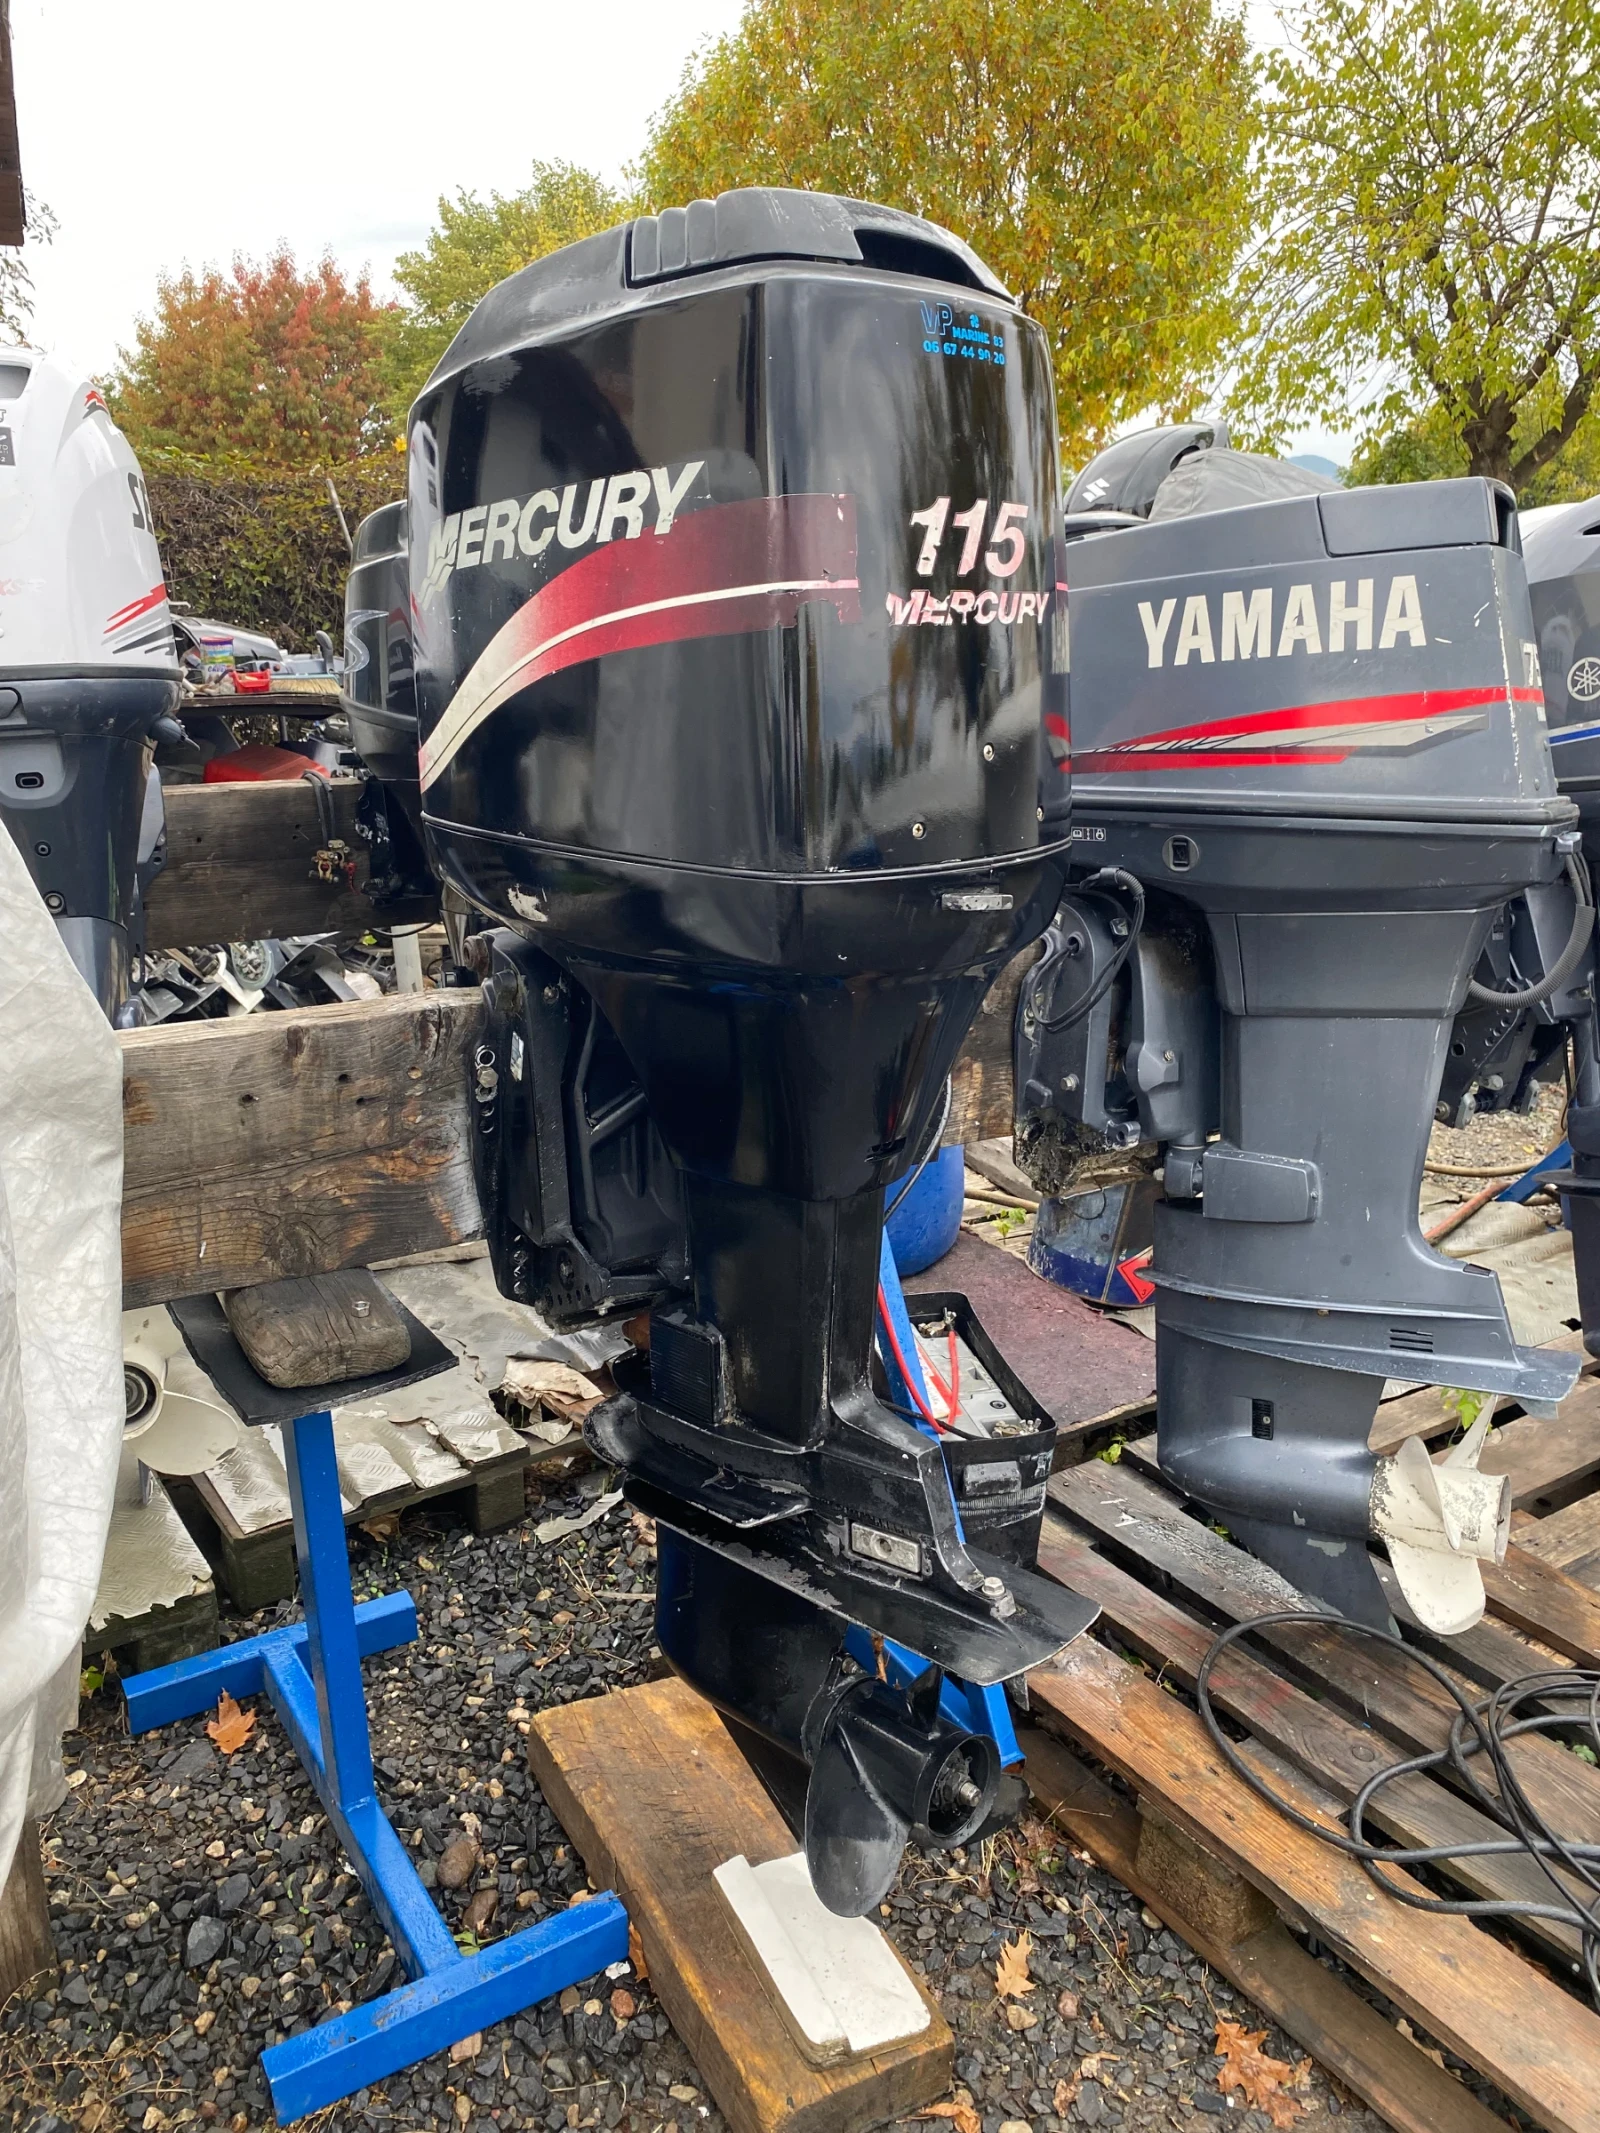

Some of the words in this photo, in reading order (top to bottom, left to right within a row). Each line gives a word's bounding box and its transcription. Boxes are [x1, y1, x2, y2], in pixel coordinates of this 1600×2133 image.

[920, 300, 952, 335] VP
[952, 326, 990, 345] MARINE
[923, 340, 940, 353] 06
[943, 342, 957, 355] 67
[960, 345, 975, 358] 44
[993, 351, 1005, 365] 20
[418, 460, 705, 605] MERCURY
[910, 495, 1029, 578] 115
[886, 588, 1050, 627] MERCURY
[1137, 574, 1428, 669] YAMAHA
